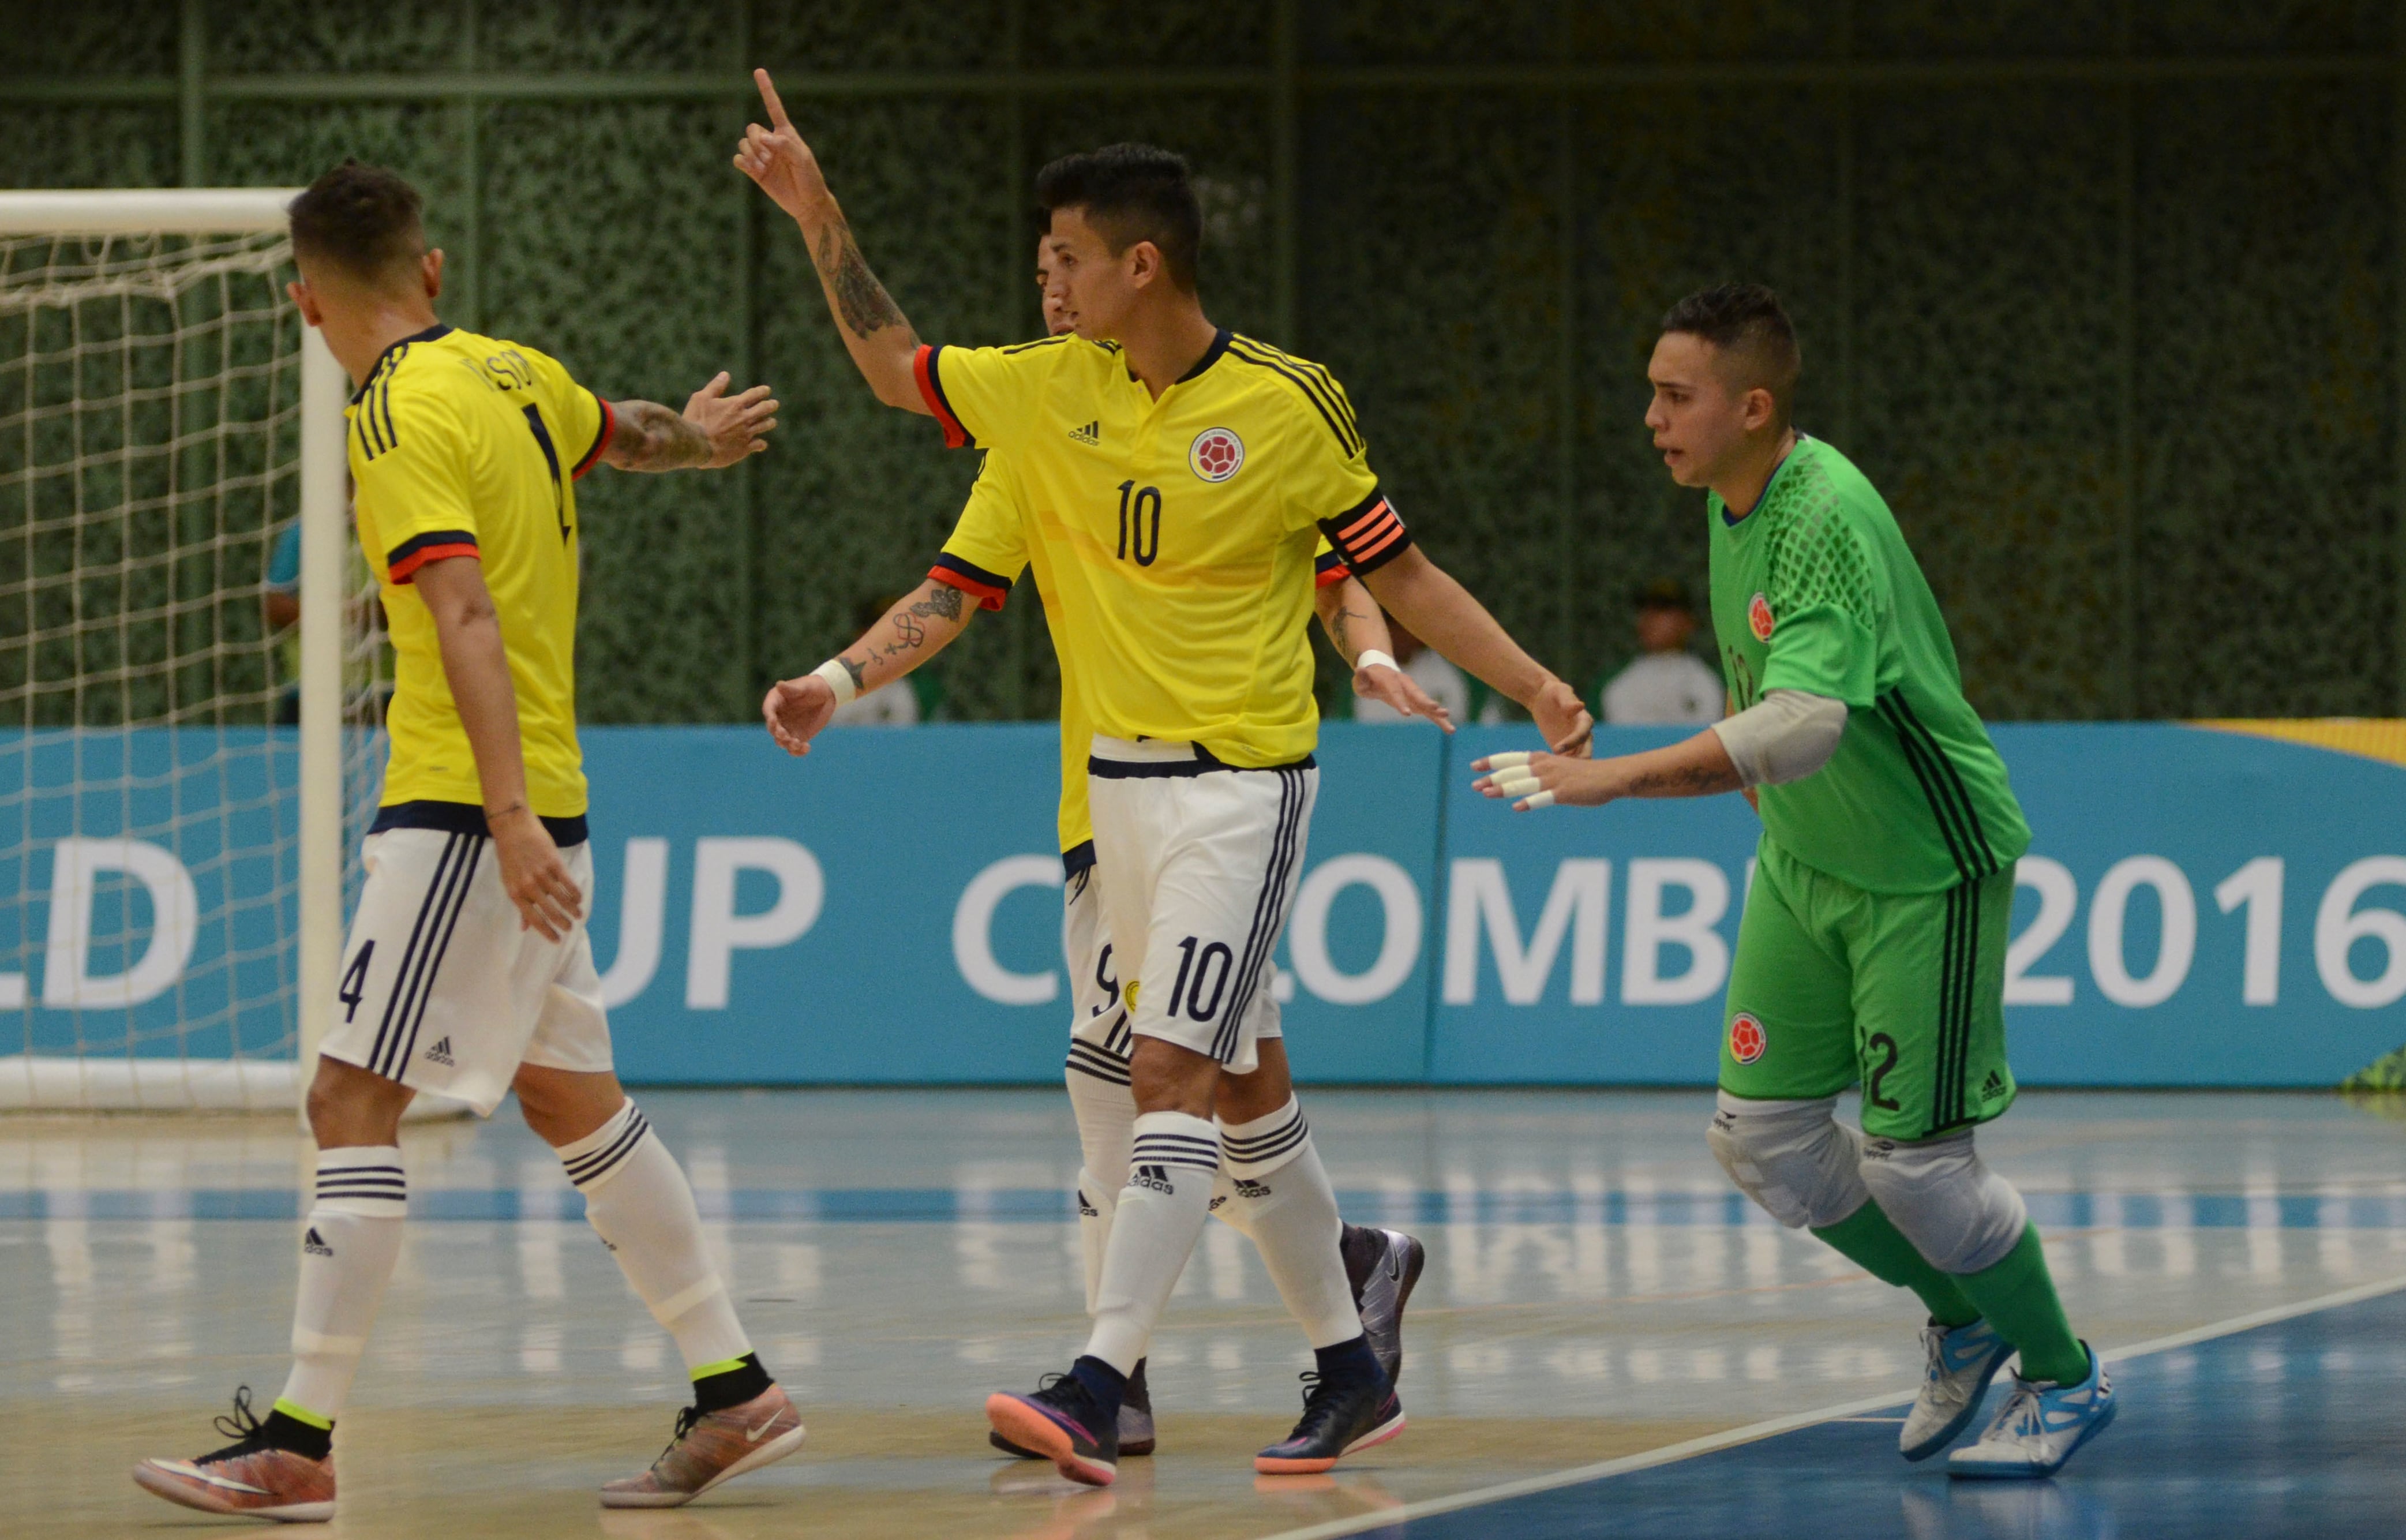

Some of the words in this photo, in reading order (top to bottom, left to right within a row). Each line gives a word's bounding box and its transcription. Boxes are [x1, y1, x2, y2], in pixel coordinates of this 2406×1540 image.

[1069, 430, 1100, 446] adidas
[1117, 479, 1161, 567] 10
[601, 835, 825, 1010] UP
[953, 852, 1757, 1006] COMB
[2003, 854, 2406, 1009] 2016
[339, 939, 376, 1024] 4
[1092, 943, 1119, 1018] 9
[1167, 936, 1232, 1022] 10
